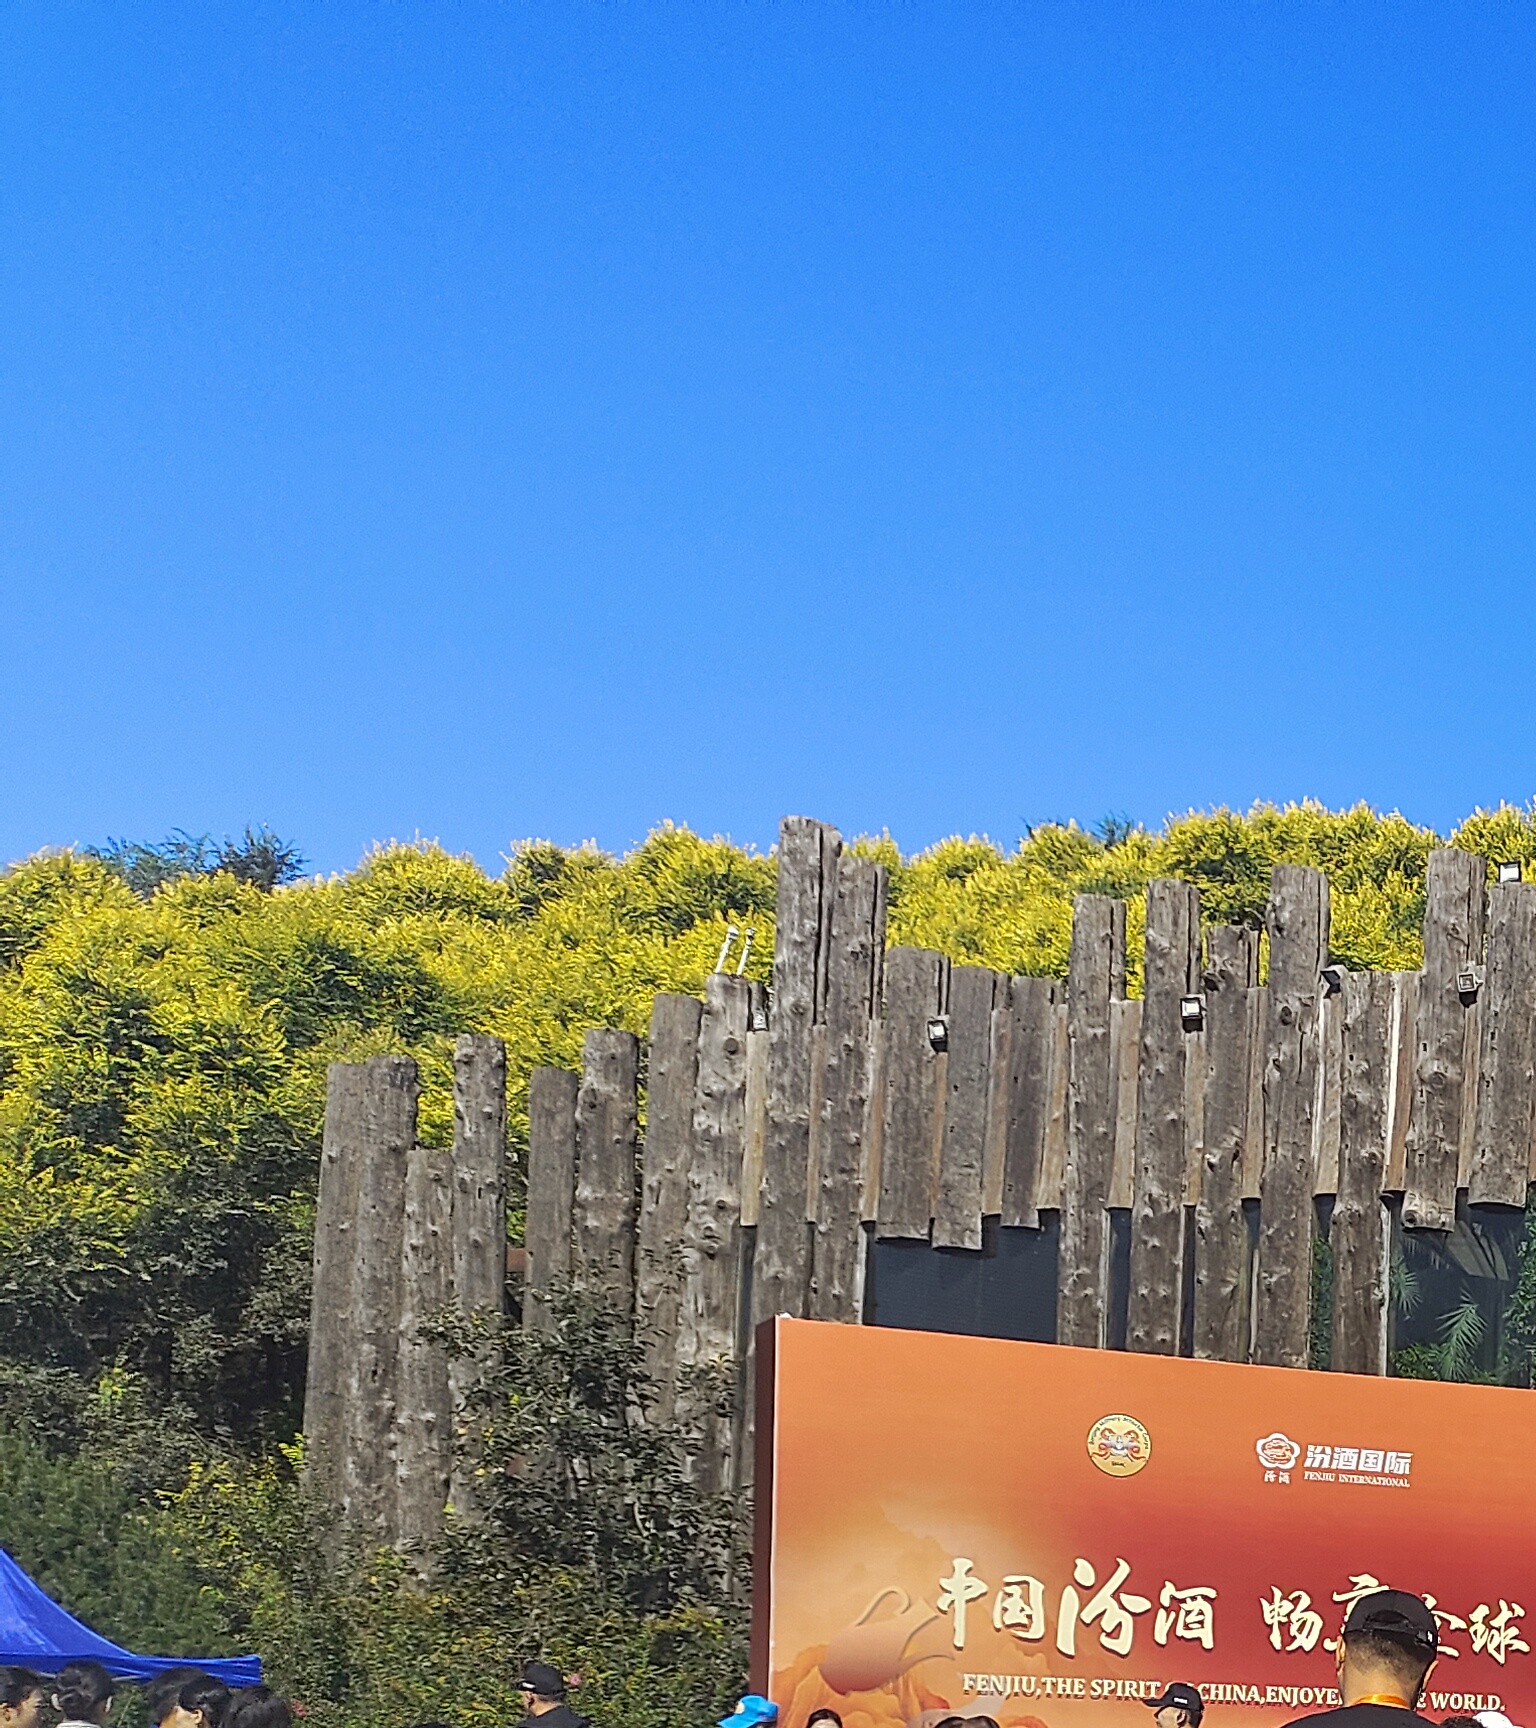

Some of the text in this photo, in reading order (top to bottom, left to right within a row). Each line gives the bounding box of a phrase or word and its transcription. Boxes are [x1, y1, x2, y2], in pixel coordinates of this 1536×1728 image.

[1304, 1444, 1413, 1475] 汾酒国际
[1304, 1471, 1411, 1488] FENJIU INTERNATIONAL
[936, 1557, 1217, 1659] 中国汾酒
[1090, 1679, 1160, 1699] SPIRIT
[1428, 1692, 1506, 1712] WORLD.
